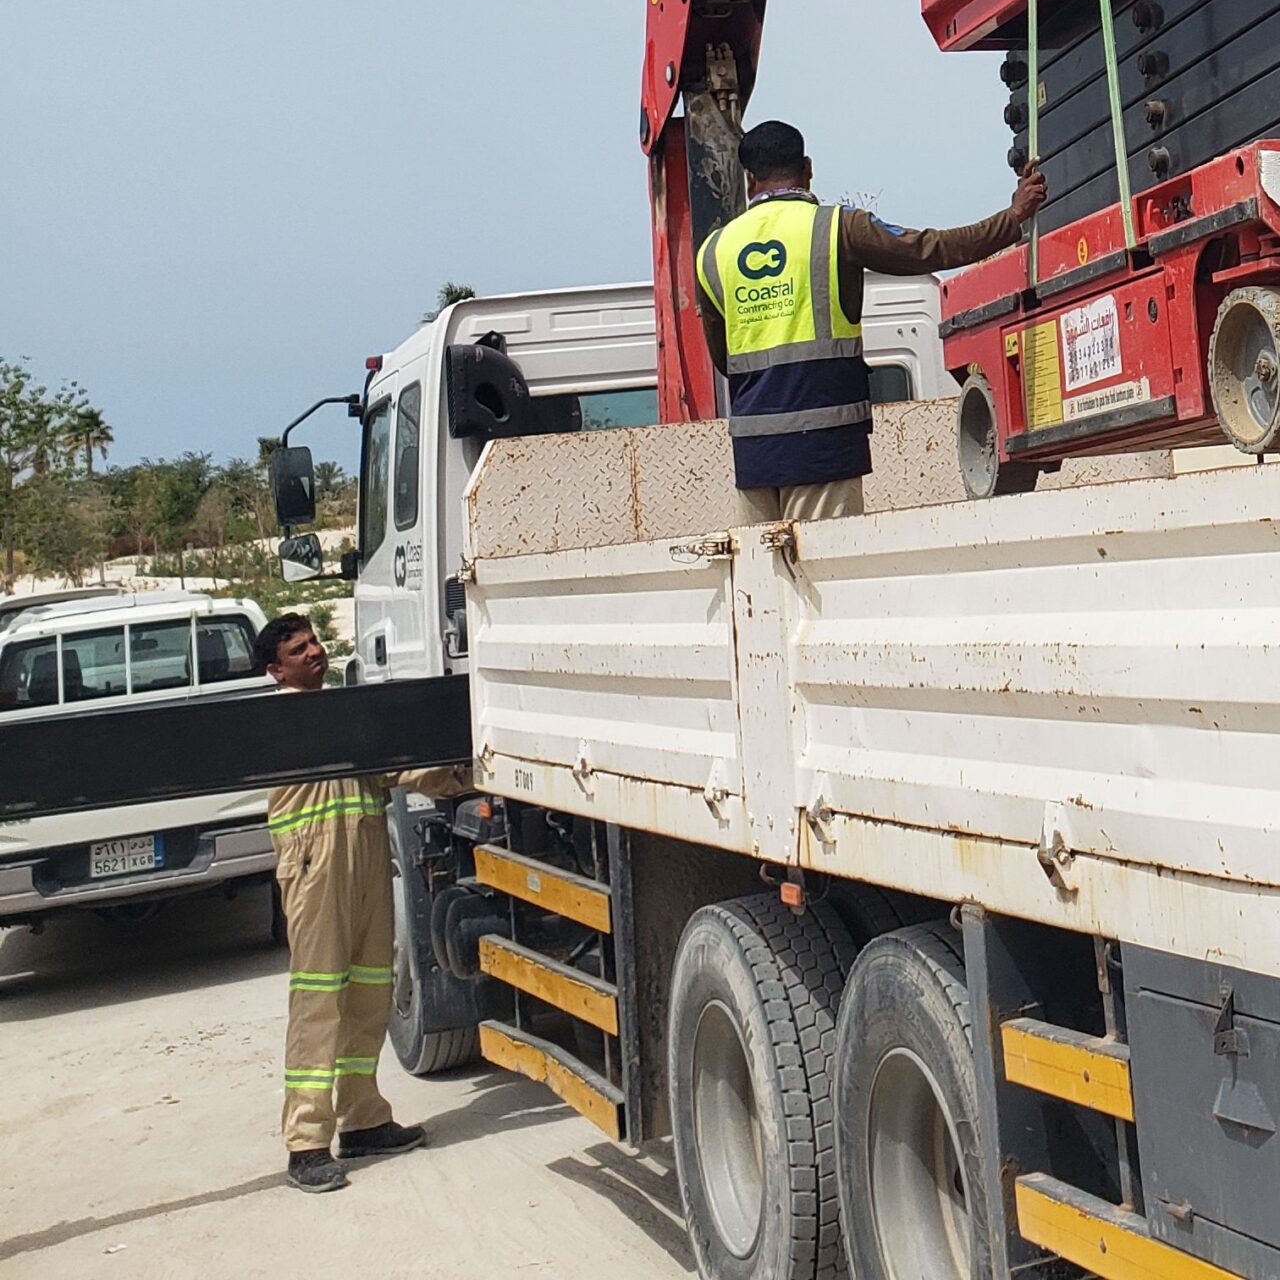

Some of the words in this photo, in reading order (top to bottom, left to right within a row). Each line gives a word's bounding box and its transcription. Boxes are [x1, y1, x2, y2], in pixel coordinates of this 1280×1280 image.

[735, 277, 793, 303] Coastal
[737, 300, 783, 315] Contracting
[784, 298, 794, 307] Co
[95, 857, 126, 875] 5621
